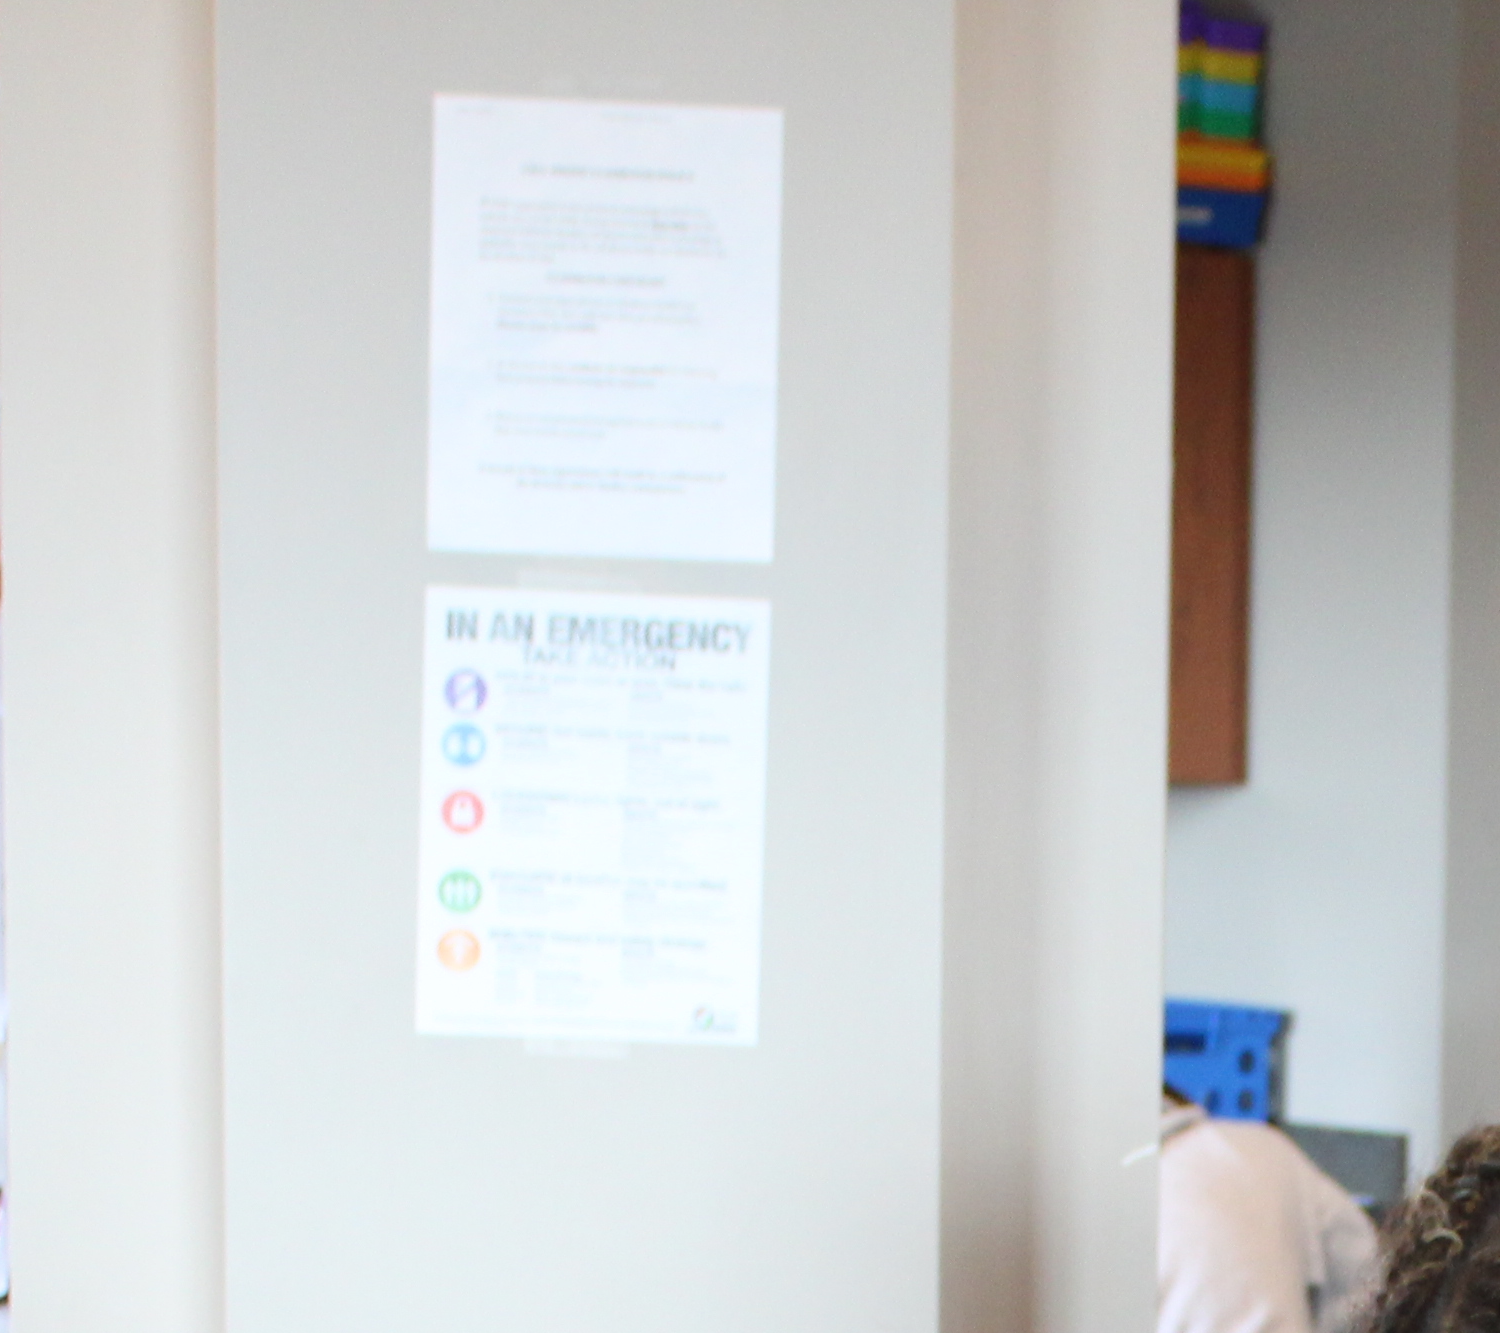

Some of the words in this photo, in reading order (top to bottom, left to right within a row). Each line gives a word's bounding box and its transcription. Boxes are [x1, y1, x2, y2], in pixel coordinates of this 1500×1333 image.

[445, 609, 479, 641] IN
[489, 610, 535, 644] AN
[548, 612, 753, 655] EMERGENCY
[522, 646, 578, 667] TAKE
